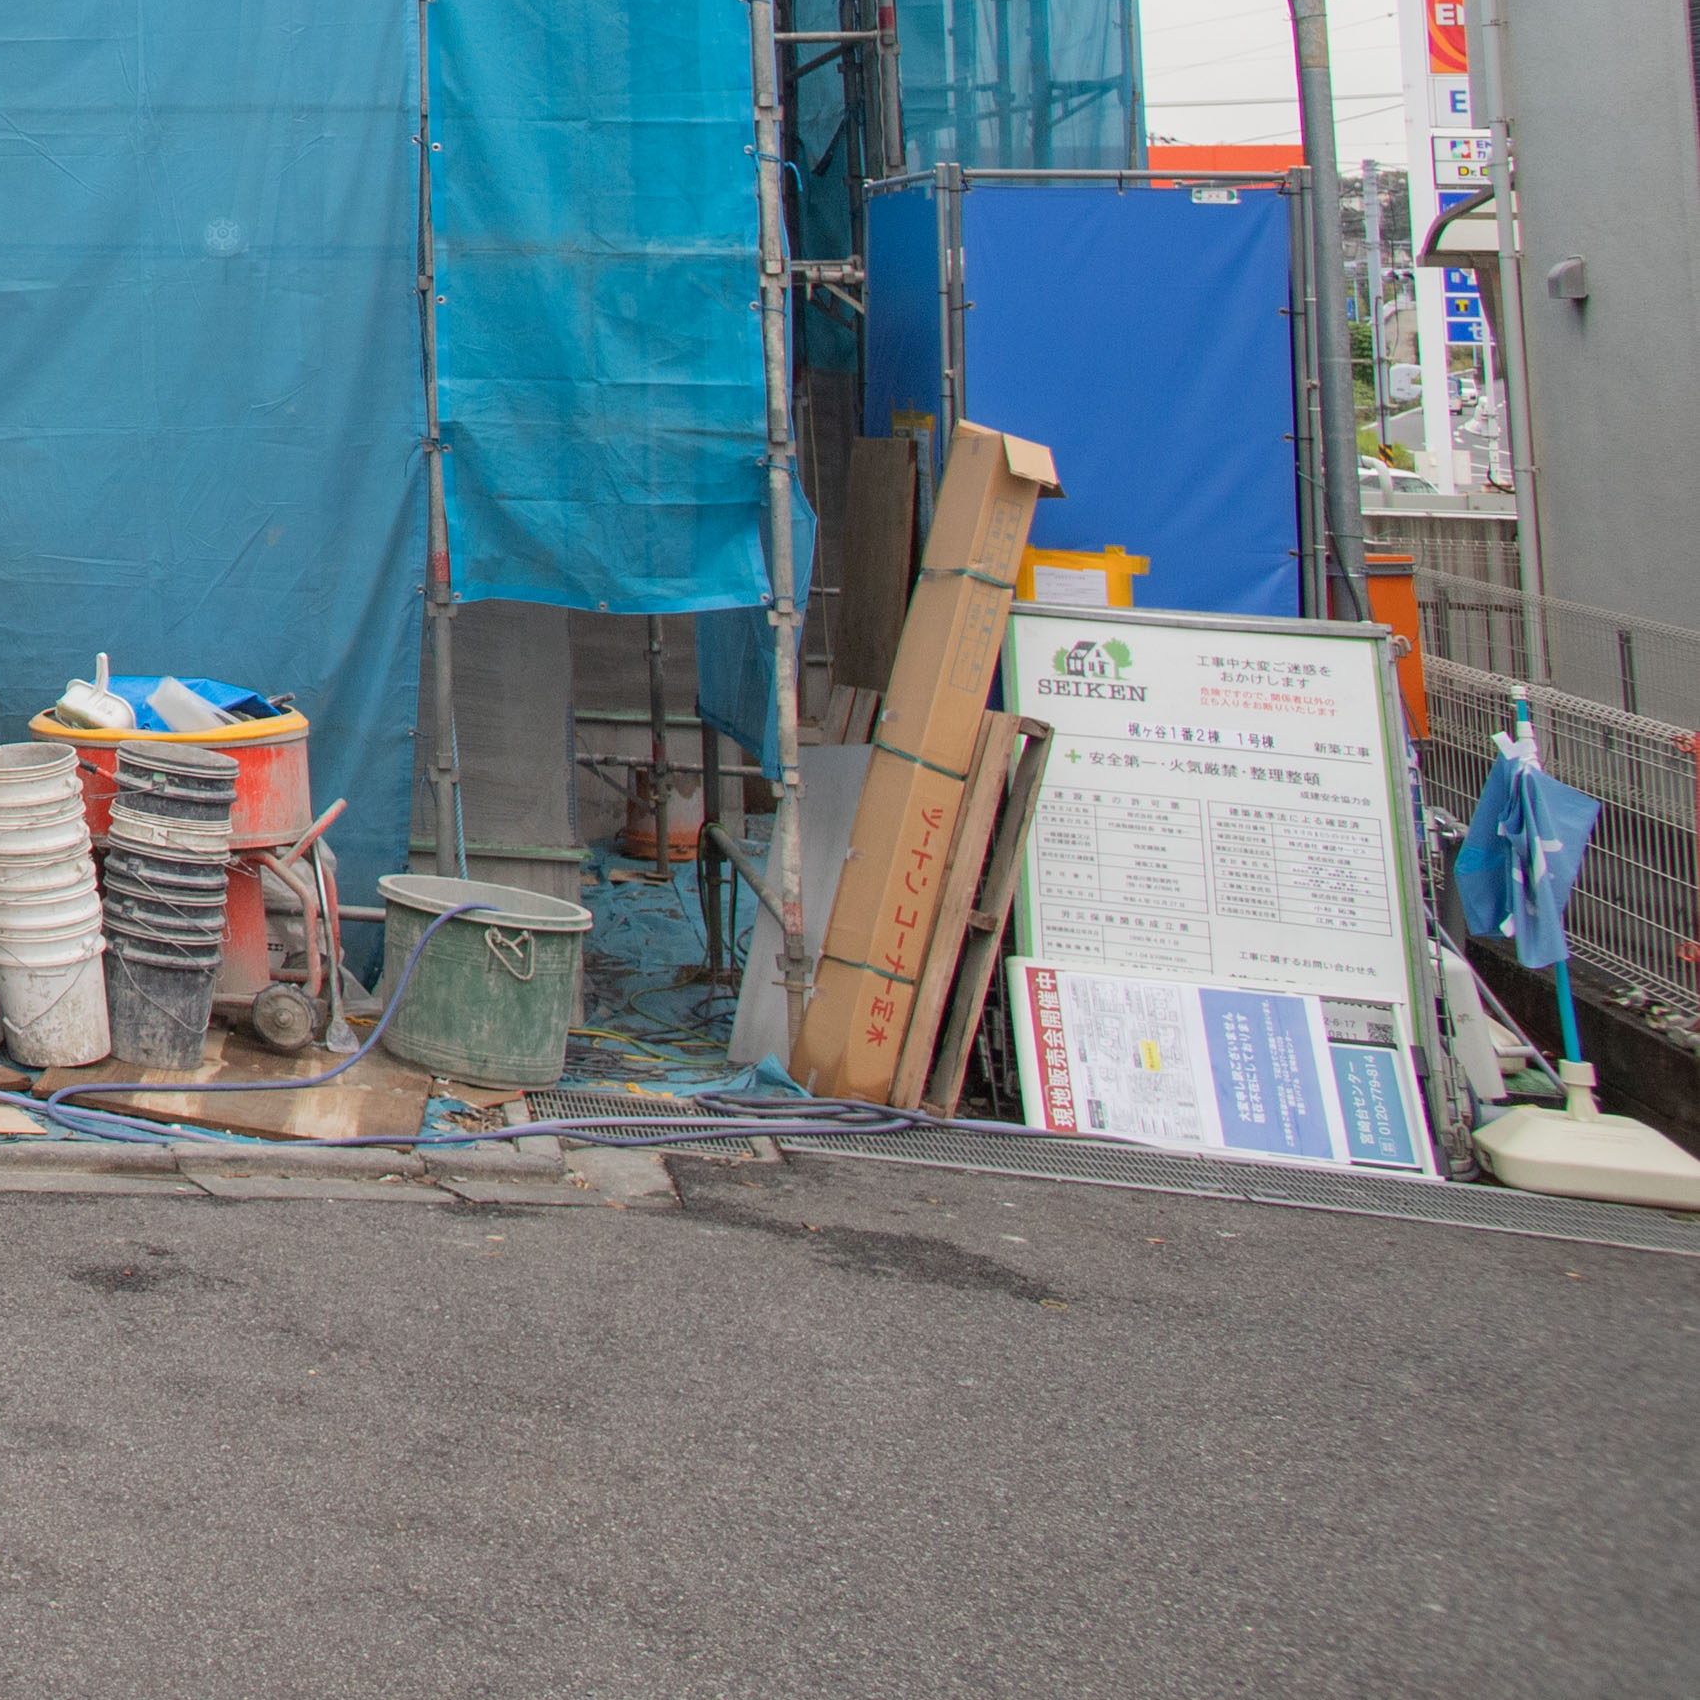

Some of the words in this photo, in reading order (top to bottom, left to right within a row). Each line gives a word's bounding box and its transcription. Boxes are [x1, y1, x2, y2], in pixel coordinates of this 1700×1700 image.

[1197, 654, 1332, 678] 工事中大変ご迷惑を
[1038, 678, 1148, 702] SEIKEN
[1220, 671, 1310, 689] おかけします
[1200, 696, 1338, 717] 立ち入りをお断りいたします
[1314, 741, 1371, 758] 新築工事
[1300, 791, 1371, 807] 成建安全協力会
[1239, 950, 1378, 977] 工事に関するお問い合わせ先
[1035, 971, 1075, 1128] 現地販売会開催中
[1348, 1061, 1375, 1145] 宮崎台センター
